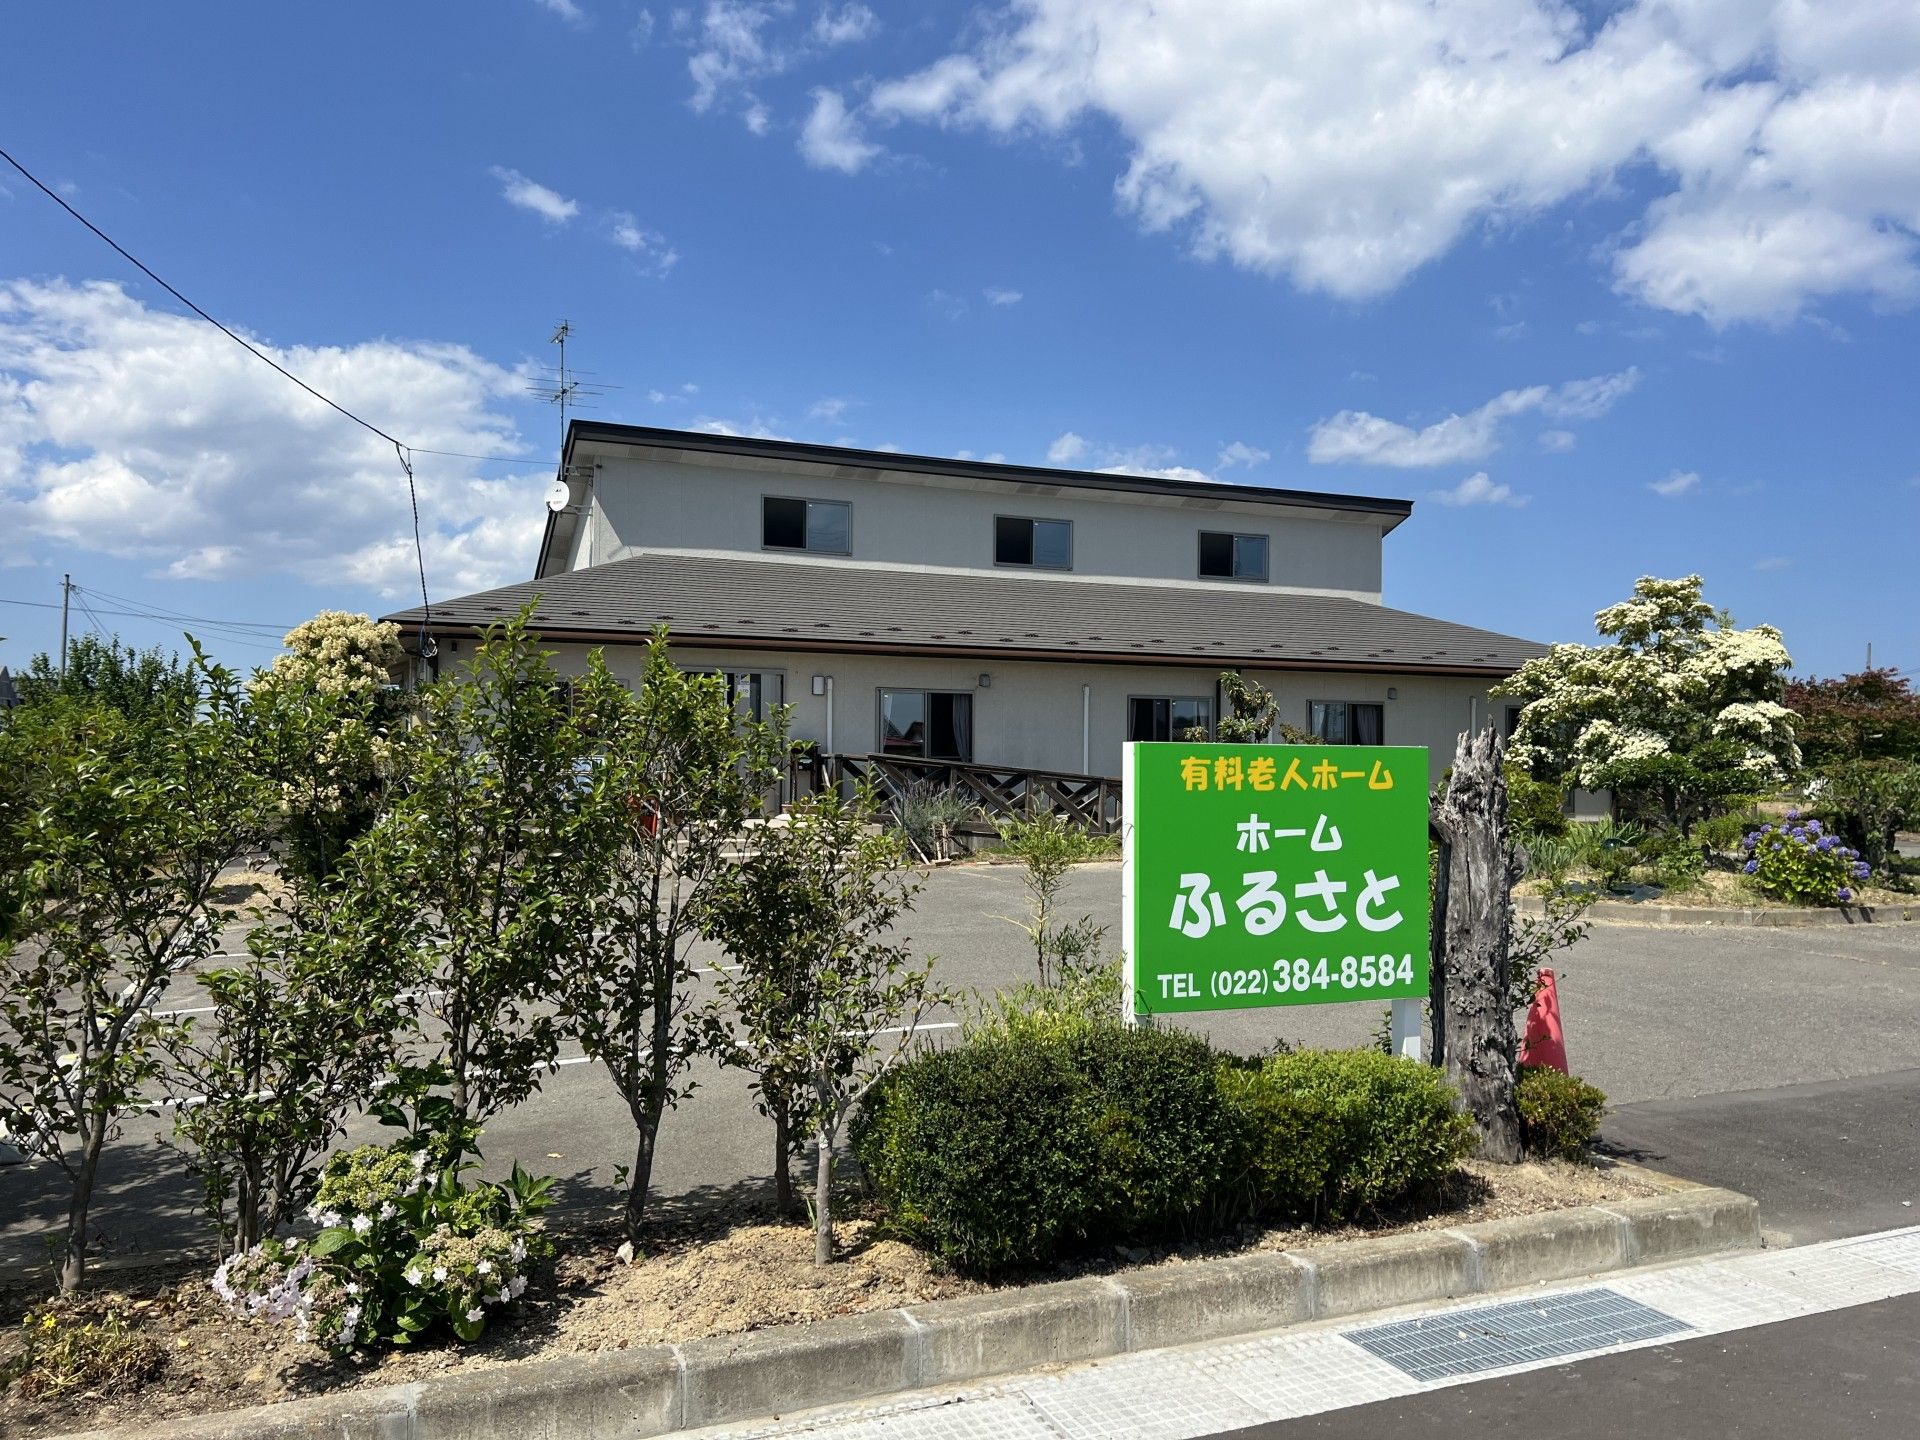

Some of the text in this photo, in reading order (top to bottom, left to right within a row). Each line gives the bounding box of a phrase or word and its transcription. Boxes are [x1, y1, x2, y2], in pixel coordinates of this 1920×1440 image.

[1181, 756, 1394, 791] 有料老人ホーム
[1237, 813, 1342, 853] ホーム
[1169, 869, 1403, 938] ふるさと
[1157, 973, 1200, 998] TEL
